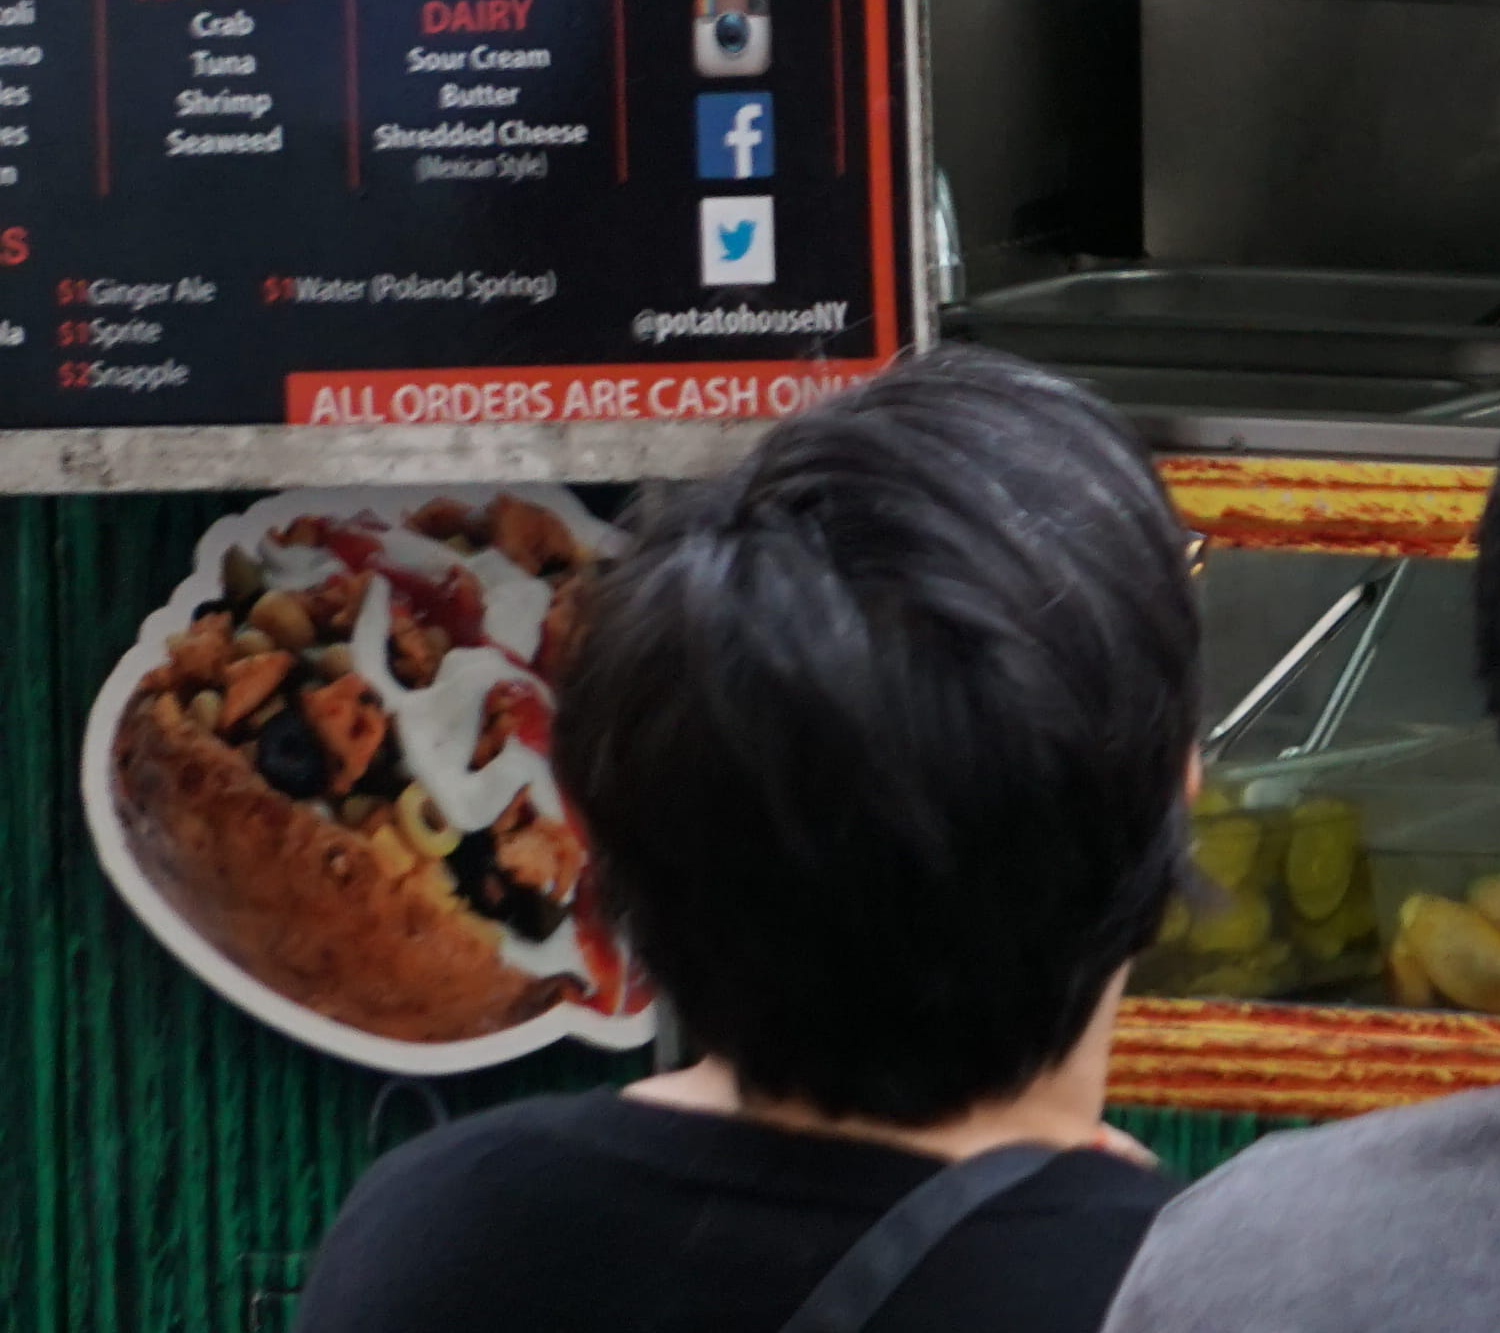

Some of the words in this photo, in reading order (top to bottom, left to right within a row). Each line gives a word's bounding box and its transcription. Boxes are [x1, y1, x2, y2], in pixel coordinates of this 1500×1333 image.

[189, 10, 256, 38] Crab
[189, 49, 257, 78] Tuna
[405, 46, 467, 74] Sour
[470, 44, 551, 70] Cream
[175, 89, 273, 120] Shrimp
[439, 83, 521, 109] Butter
[166, 126, 285, 157] Seaweed
[372, 120, 495, 152] Shredded
[499, 119, 589, 146] Cheese
[632, 301, 848, 344] @potatohouseNY
[311, 386, 384, 423] ALL
[392, 382, 554, 422] ORDERS
[563, 379, 640, 418] ARE
[648, 375, 757, 417] CASH
[769, 375, 863, 413] ON
